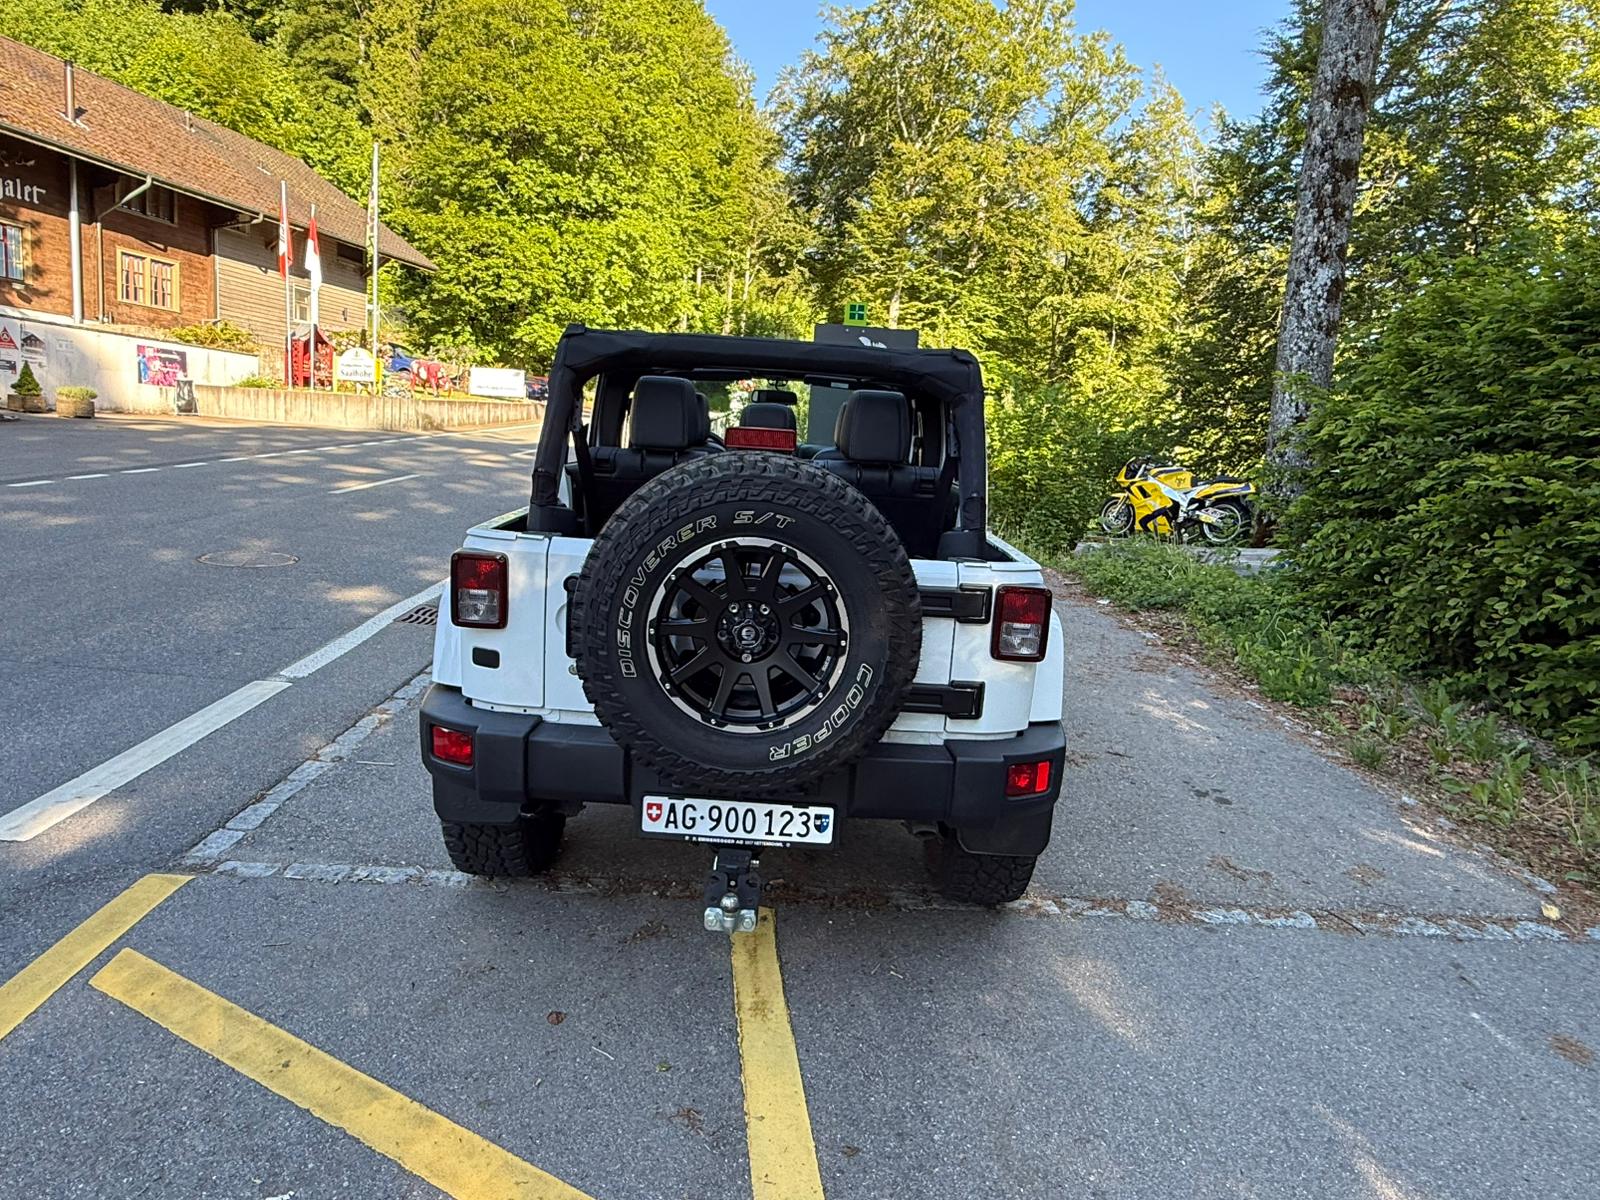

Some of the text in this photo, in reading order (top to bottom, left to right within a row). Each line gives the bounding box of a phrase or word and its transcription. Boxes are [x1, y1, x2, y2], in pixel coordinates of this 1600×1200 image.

[617, 510, 796, 678] DISCOVERER S/T
[769, 663, 873, 761] COOPER
[764, 809, 811, 838] 123
